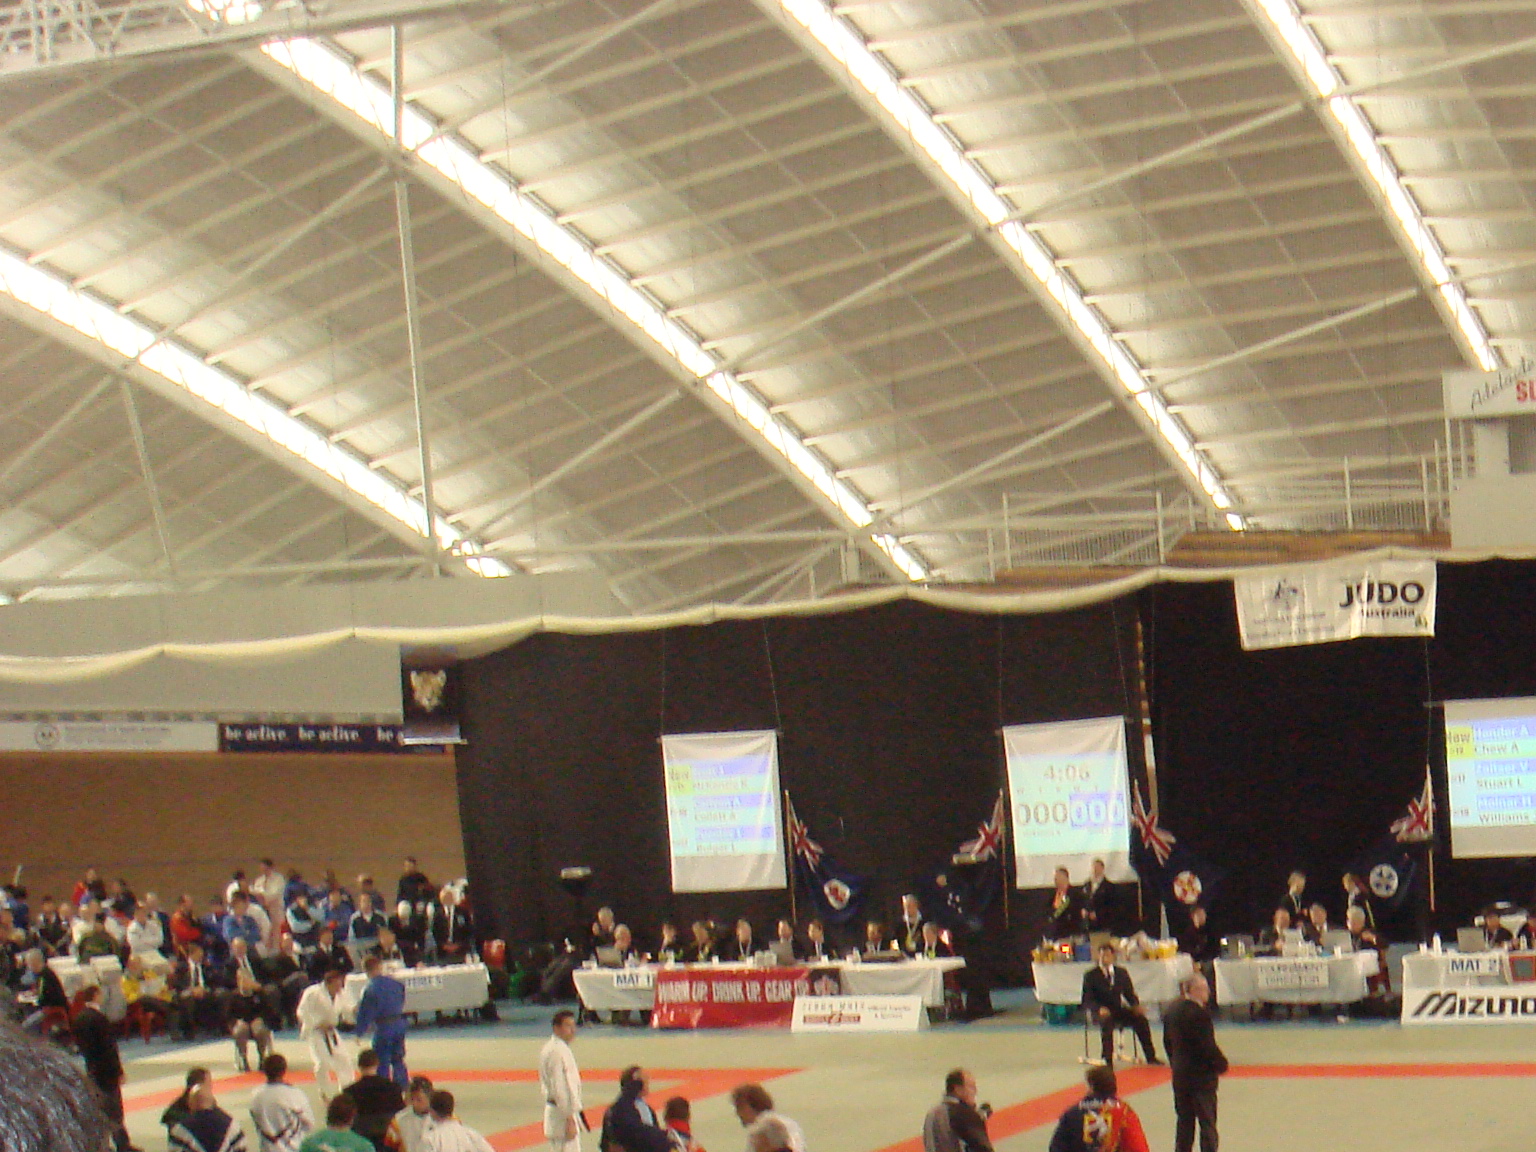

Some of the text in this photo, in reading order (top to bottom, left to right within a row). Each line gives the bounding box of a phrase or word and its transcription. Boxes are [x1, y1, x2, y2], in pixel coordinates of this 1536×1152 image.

[1339, 581, 1425, 608] JUDO
[1361, 607, 1415, 620] ustralia
[1451, 958, 1481, 972] MAT
